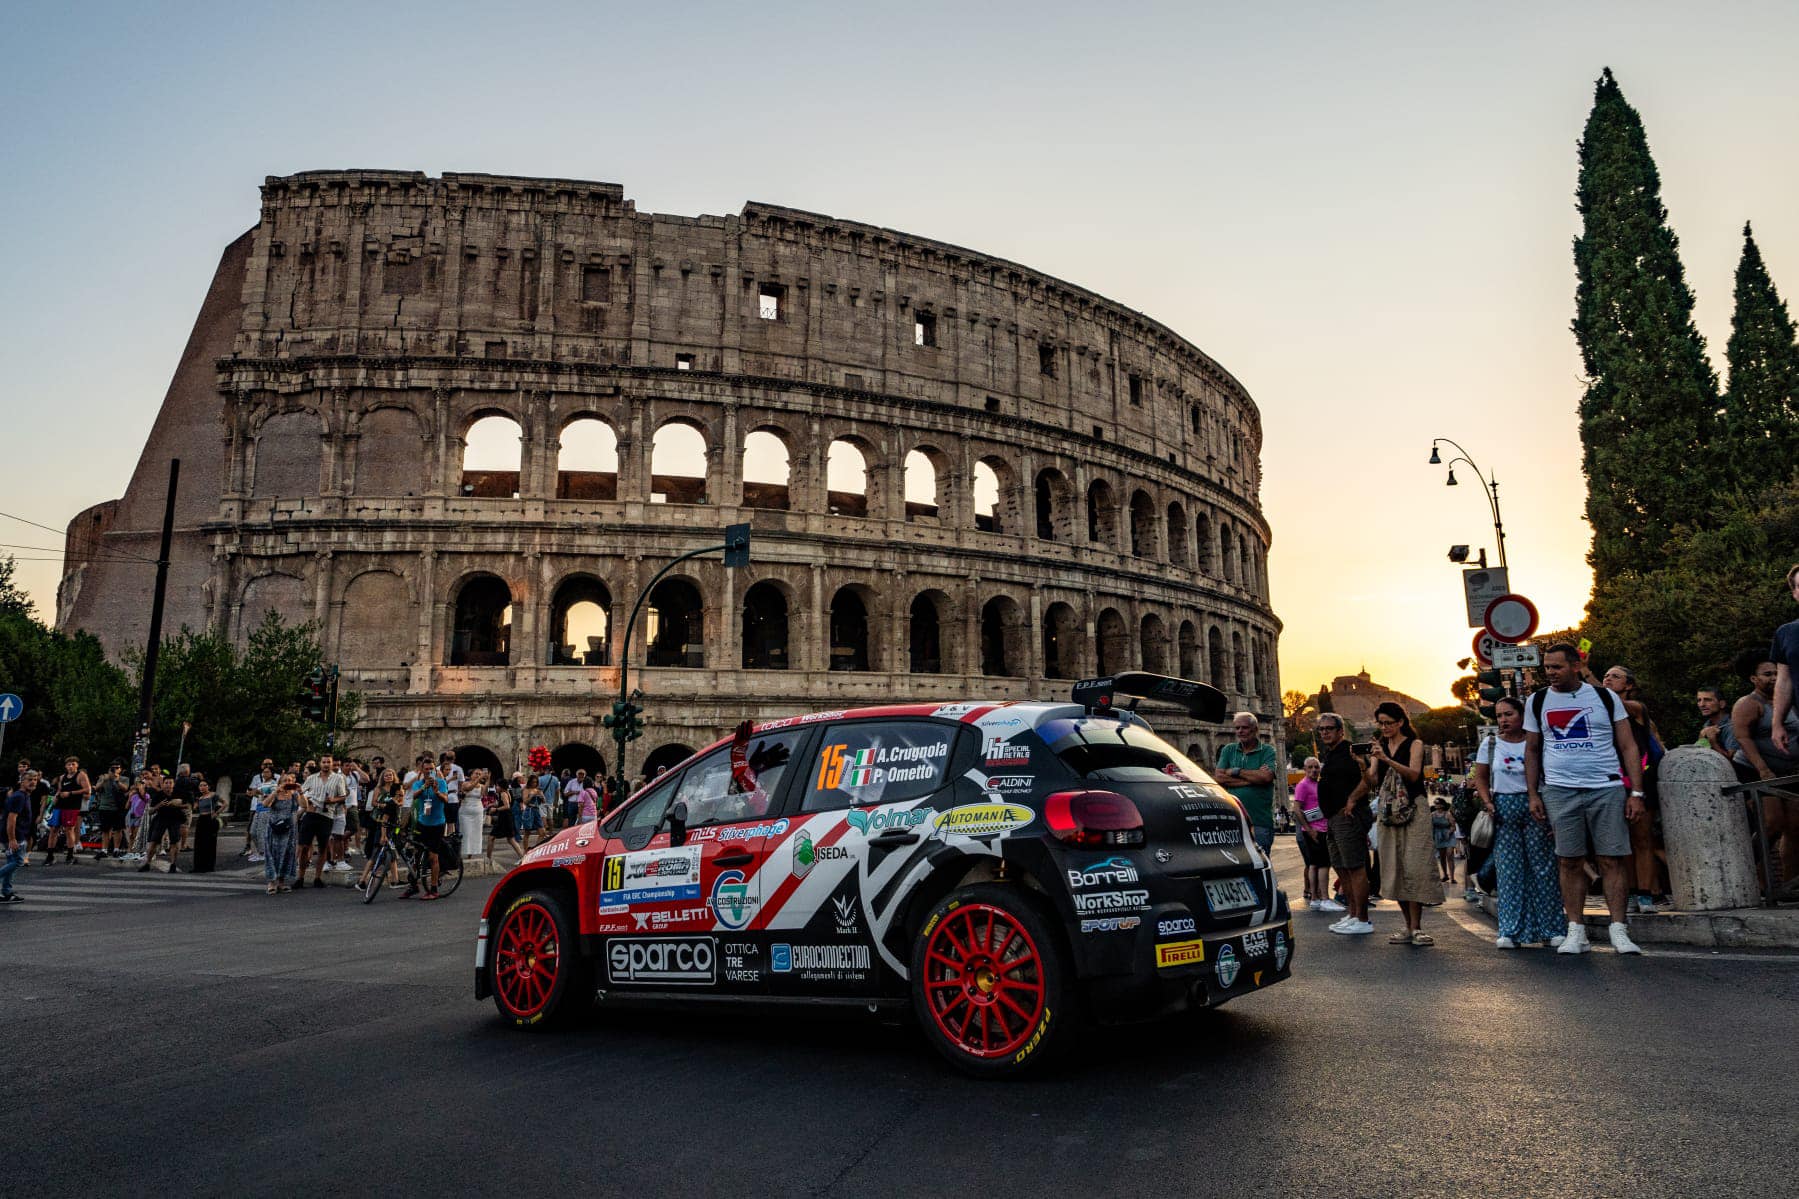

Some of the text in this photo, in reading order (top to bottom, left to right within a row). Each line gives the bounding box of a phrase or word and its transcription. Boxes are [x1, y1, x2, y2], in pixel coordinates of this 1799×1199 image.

[876, 742, 948, 764] A.Crugnola
[816, 744, 848, 791] 15
[872, 764, 933, 784] P. Ometto
[847, 807, 934, 836] Volmar
[817, 846, 848, 860] ISEDA
[607, 857, 622, 891] 15
[1068, 867, 1139, 888] Borrelli
[652, 908, 708, 923] BELLETTI
[1158, 918, 1196, 935] sparco
[725, 943, 759, 954] OTTICA
[792, 945, 871, 969] EUROCONNECTION
[1161, 943, 1200, 963] PIRELLI
[611, 942, 712, 980] sparco
[726, 957, 743, 968] TRE
[725, 970, 759, 981] VARESE
